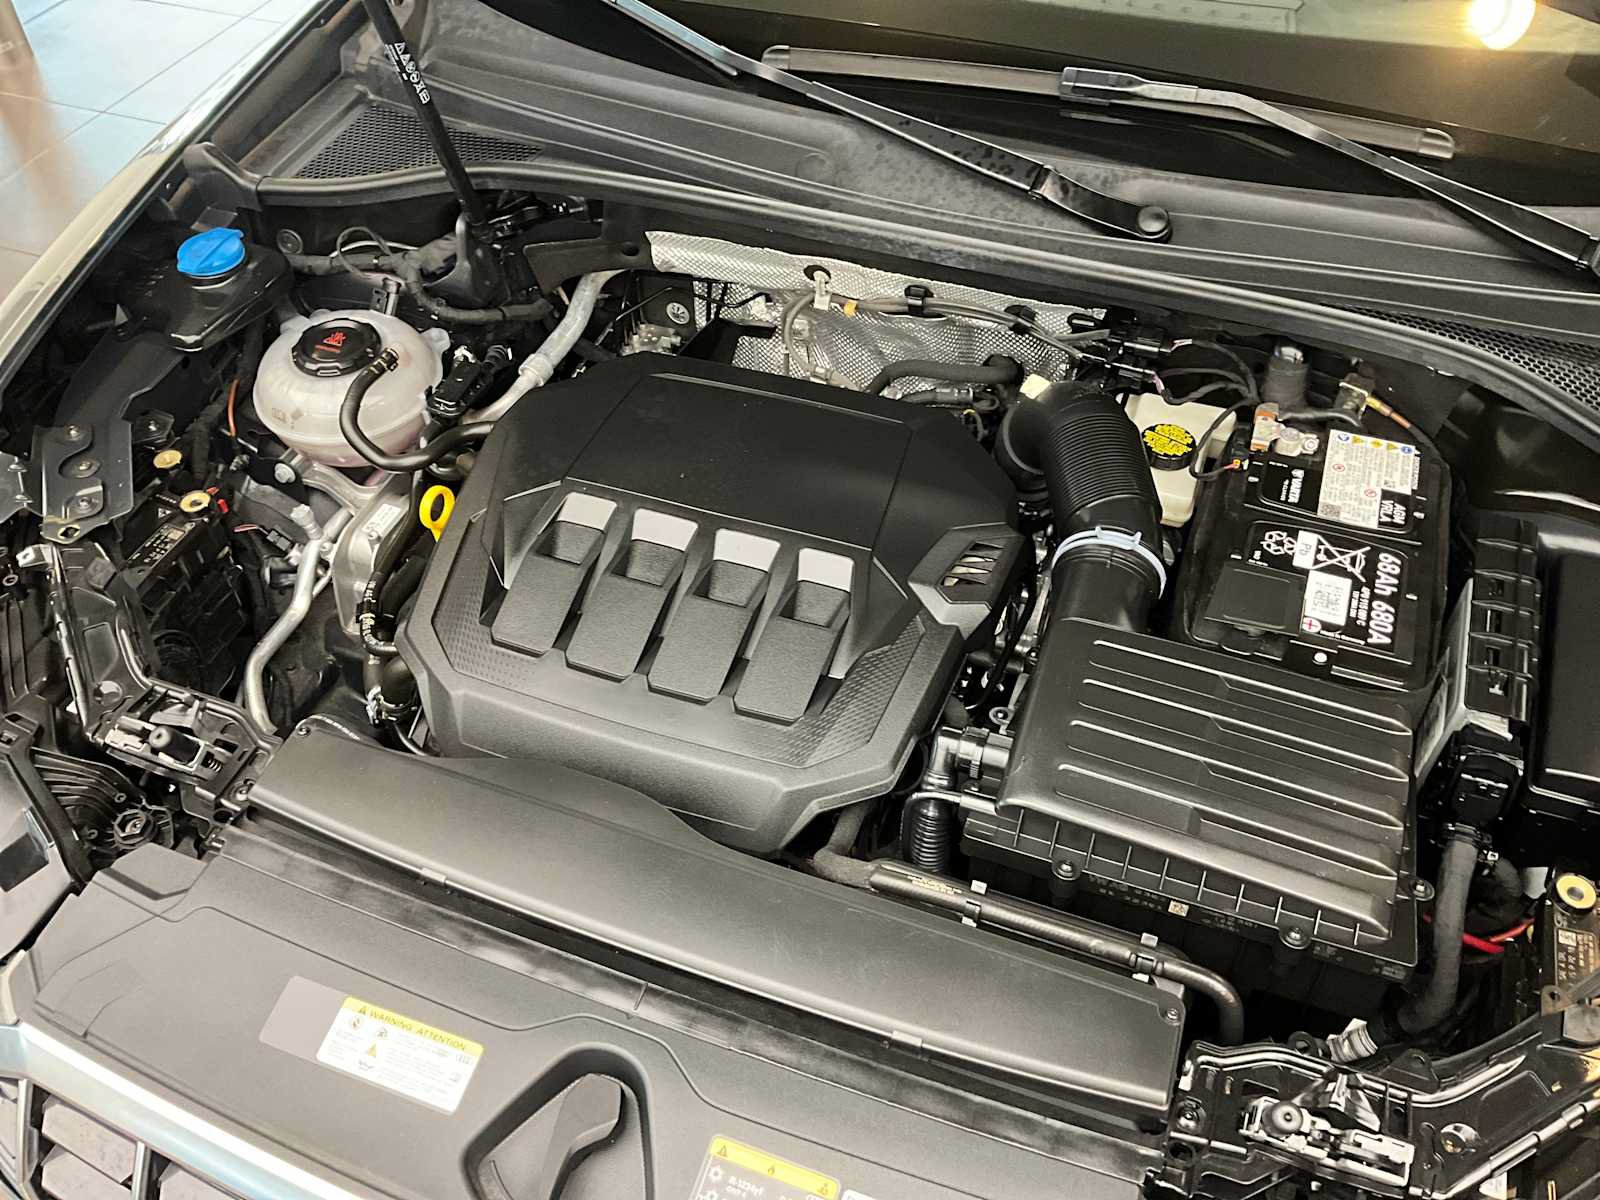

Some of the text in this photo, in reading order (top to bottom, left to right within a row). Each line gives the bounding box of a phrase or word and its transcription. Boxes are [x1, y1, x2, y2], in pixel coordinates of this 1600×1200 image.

[1380, 500, 1394, 522] VRLA
[1393, 502, 1406, 525] AGM
[1299, 542, 1312, 556] Pb
[1367, 552, 1401, 644] 68Ah 680A
[370, 1009, 466, 1051] WARNING ATTENTION
